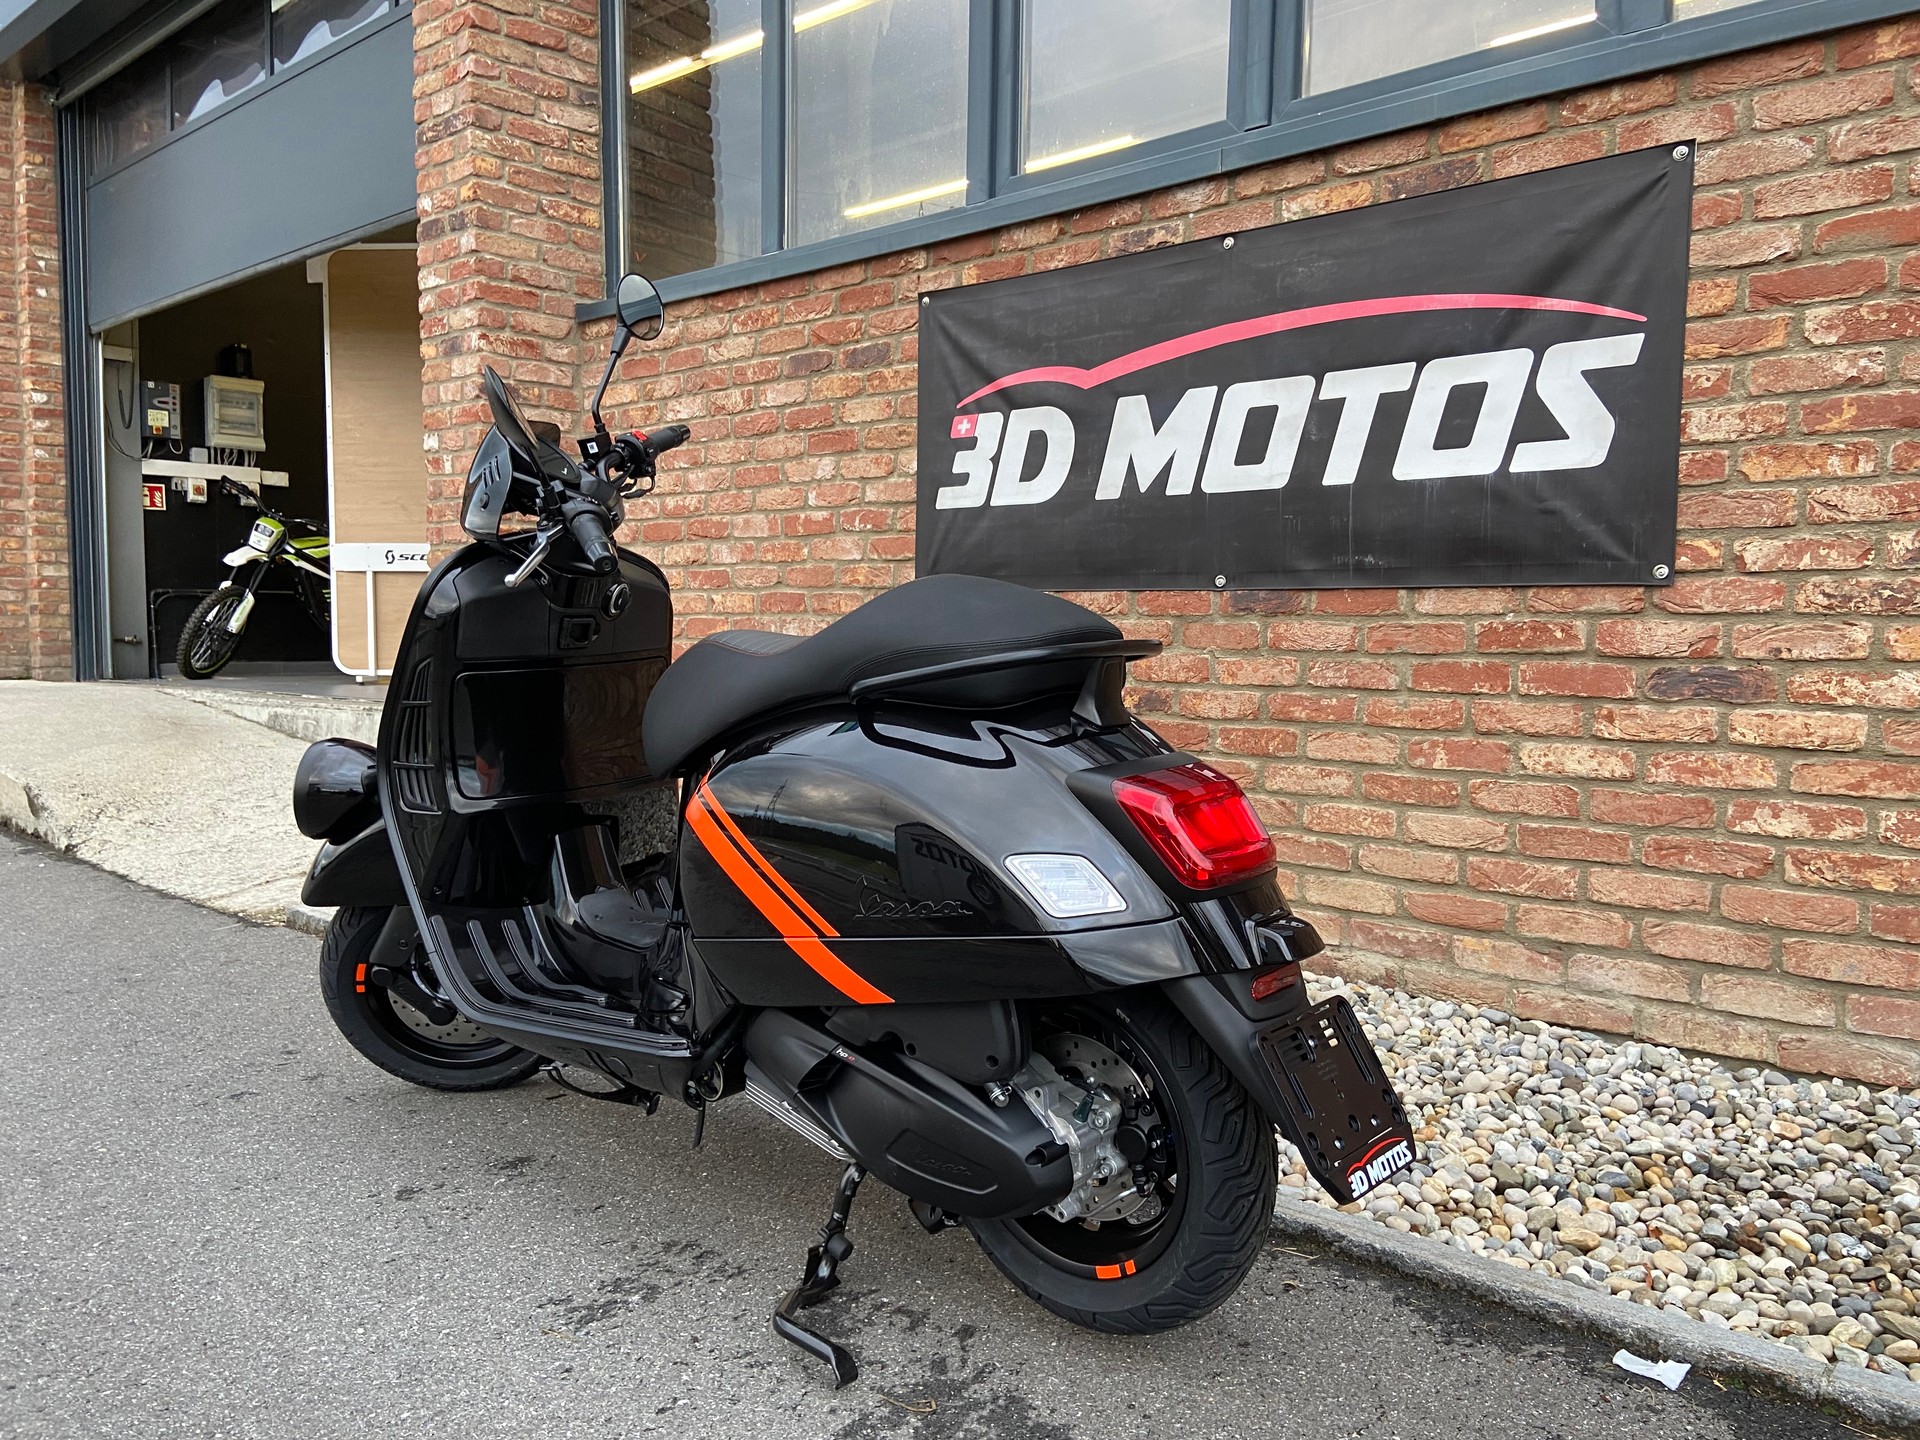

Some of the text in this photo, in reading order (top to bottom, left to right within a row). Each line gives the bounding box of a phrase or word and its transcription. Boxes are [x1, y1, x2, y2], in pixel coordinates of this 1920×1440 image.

[935, 333, 1645, 510] 3D MOTOS
[853, 874, 973, 919] Vespa
[1348, 1140, 1413, 1198] 3D MOTOS
